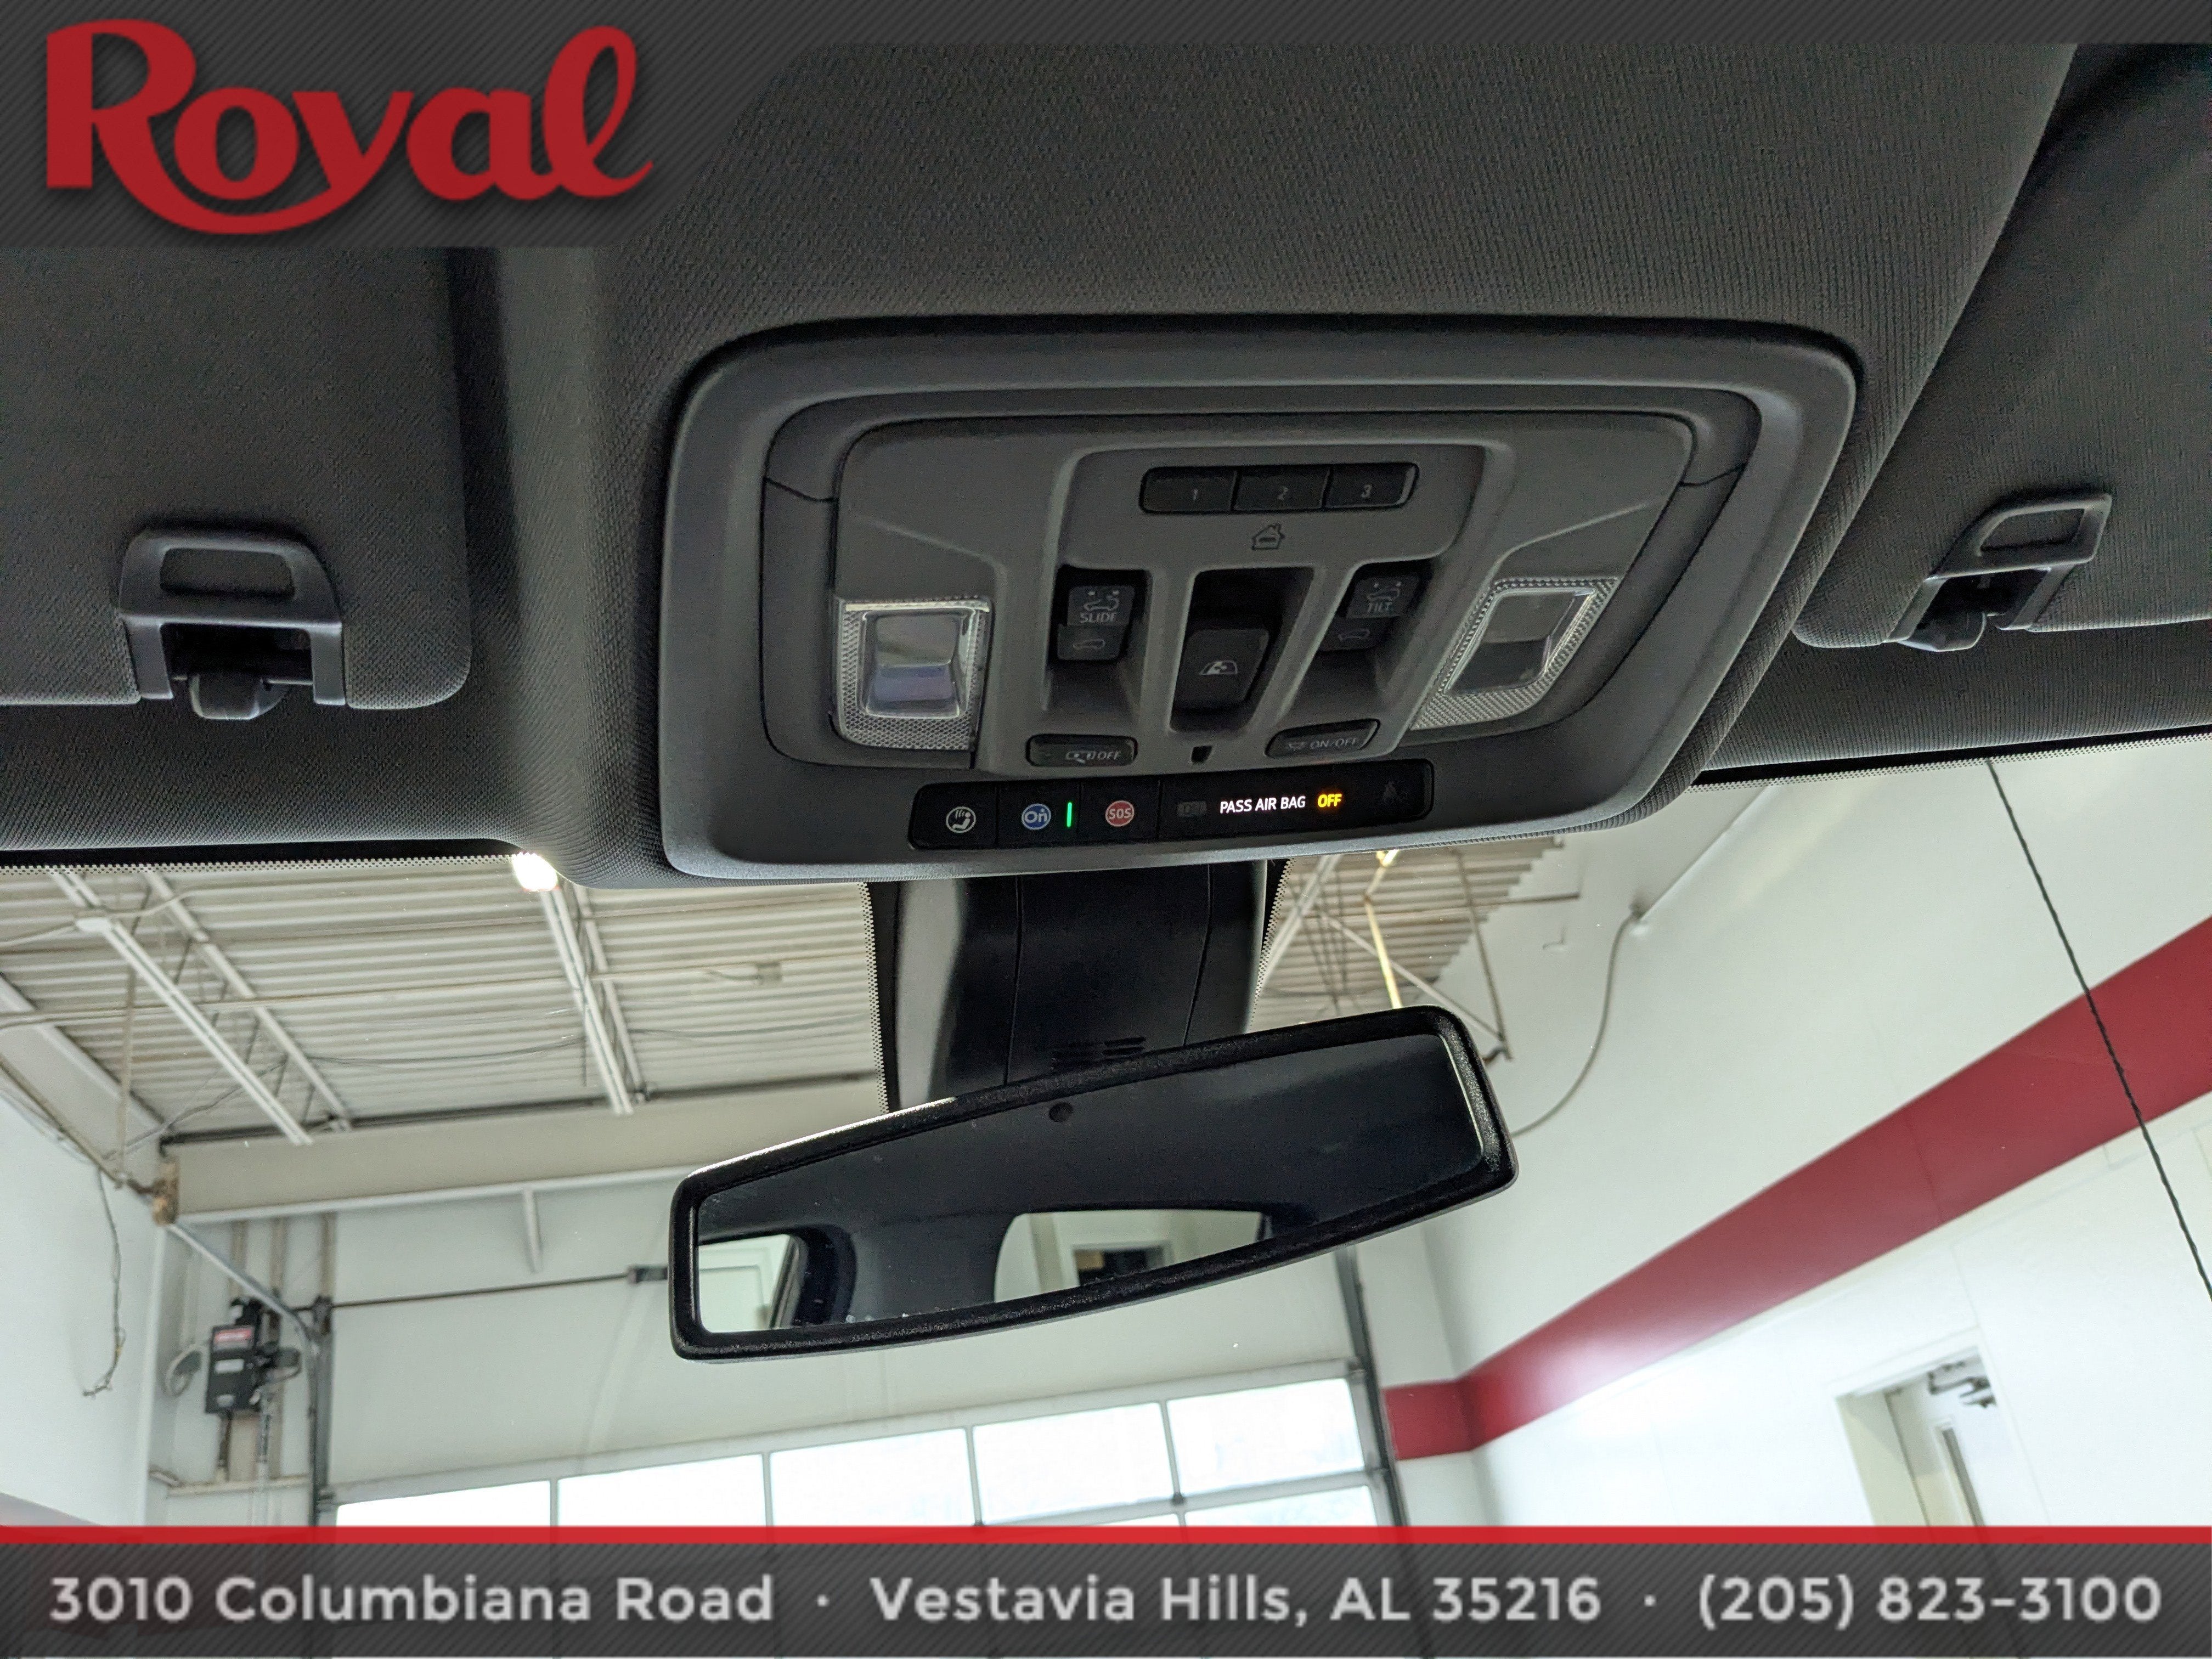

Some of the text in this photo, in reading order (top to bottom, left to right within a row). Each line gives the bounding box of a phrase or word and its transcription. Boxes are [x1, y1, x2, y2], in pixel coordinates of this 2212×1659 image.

[1191, 488, 1198, 500] 1
[1278, 487, 1288, 500] 2
[1361, 484, 1371, 499] 3
[1219, 798, 1253, 814] PASS
[1254, 797, 1277, 811] AIR
[1280, 795, 1306, 810] BAG
[1317, 793, 1342, 808] OFF
[1108, 807, 1132, 820] SOS
